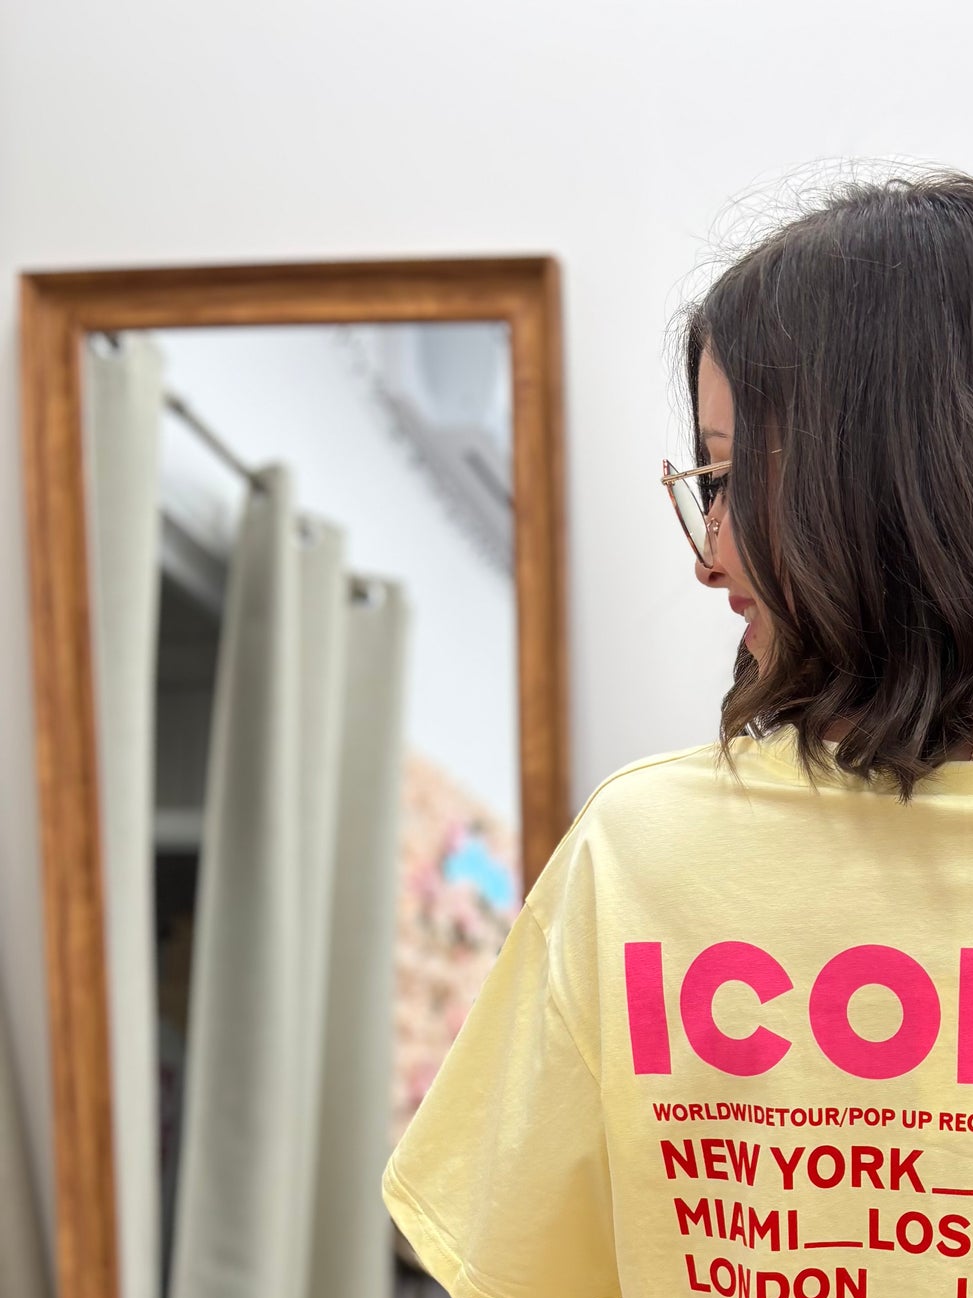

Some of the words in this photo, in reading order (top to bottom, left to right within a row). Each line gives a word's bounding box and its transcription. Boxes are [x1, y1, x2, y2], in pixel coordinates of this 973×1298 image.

[901, 1109, 933, 1130] UP
[659, 1137, 761, 1187] NEW
[769, 1144, 926, 1194] YORK
[673, 1197, 799, 1253] MIAMI
[868, 1207, 972, 1259] LOS
